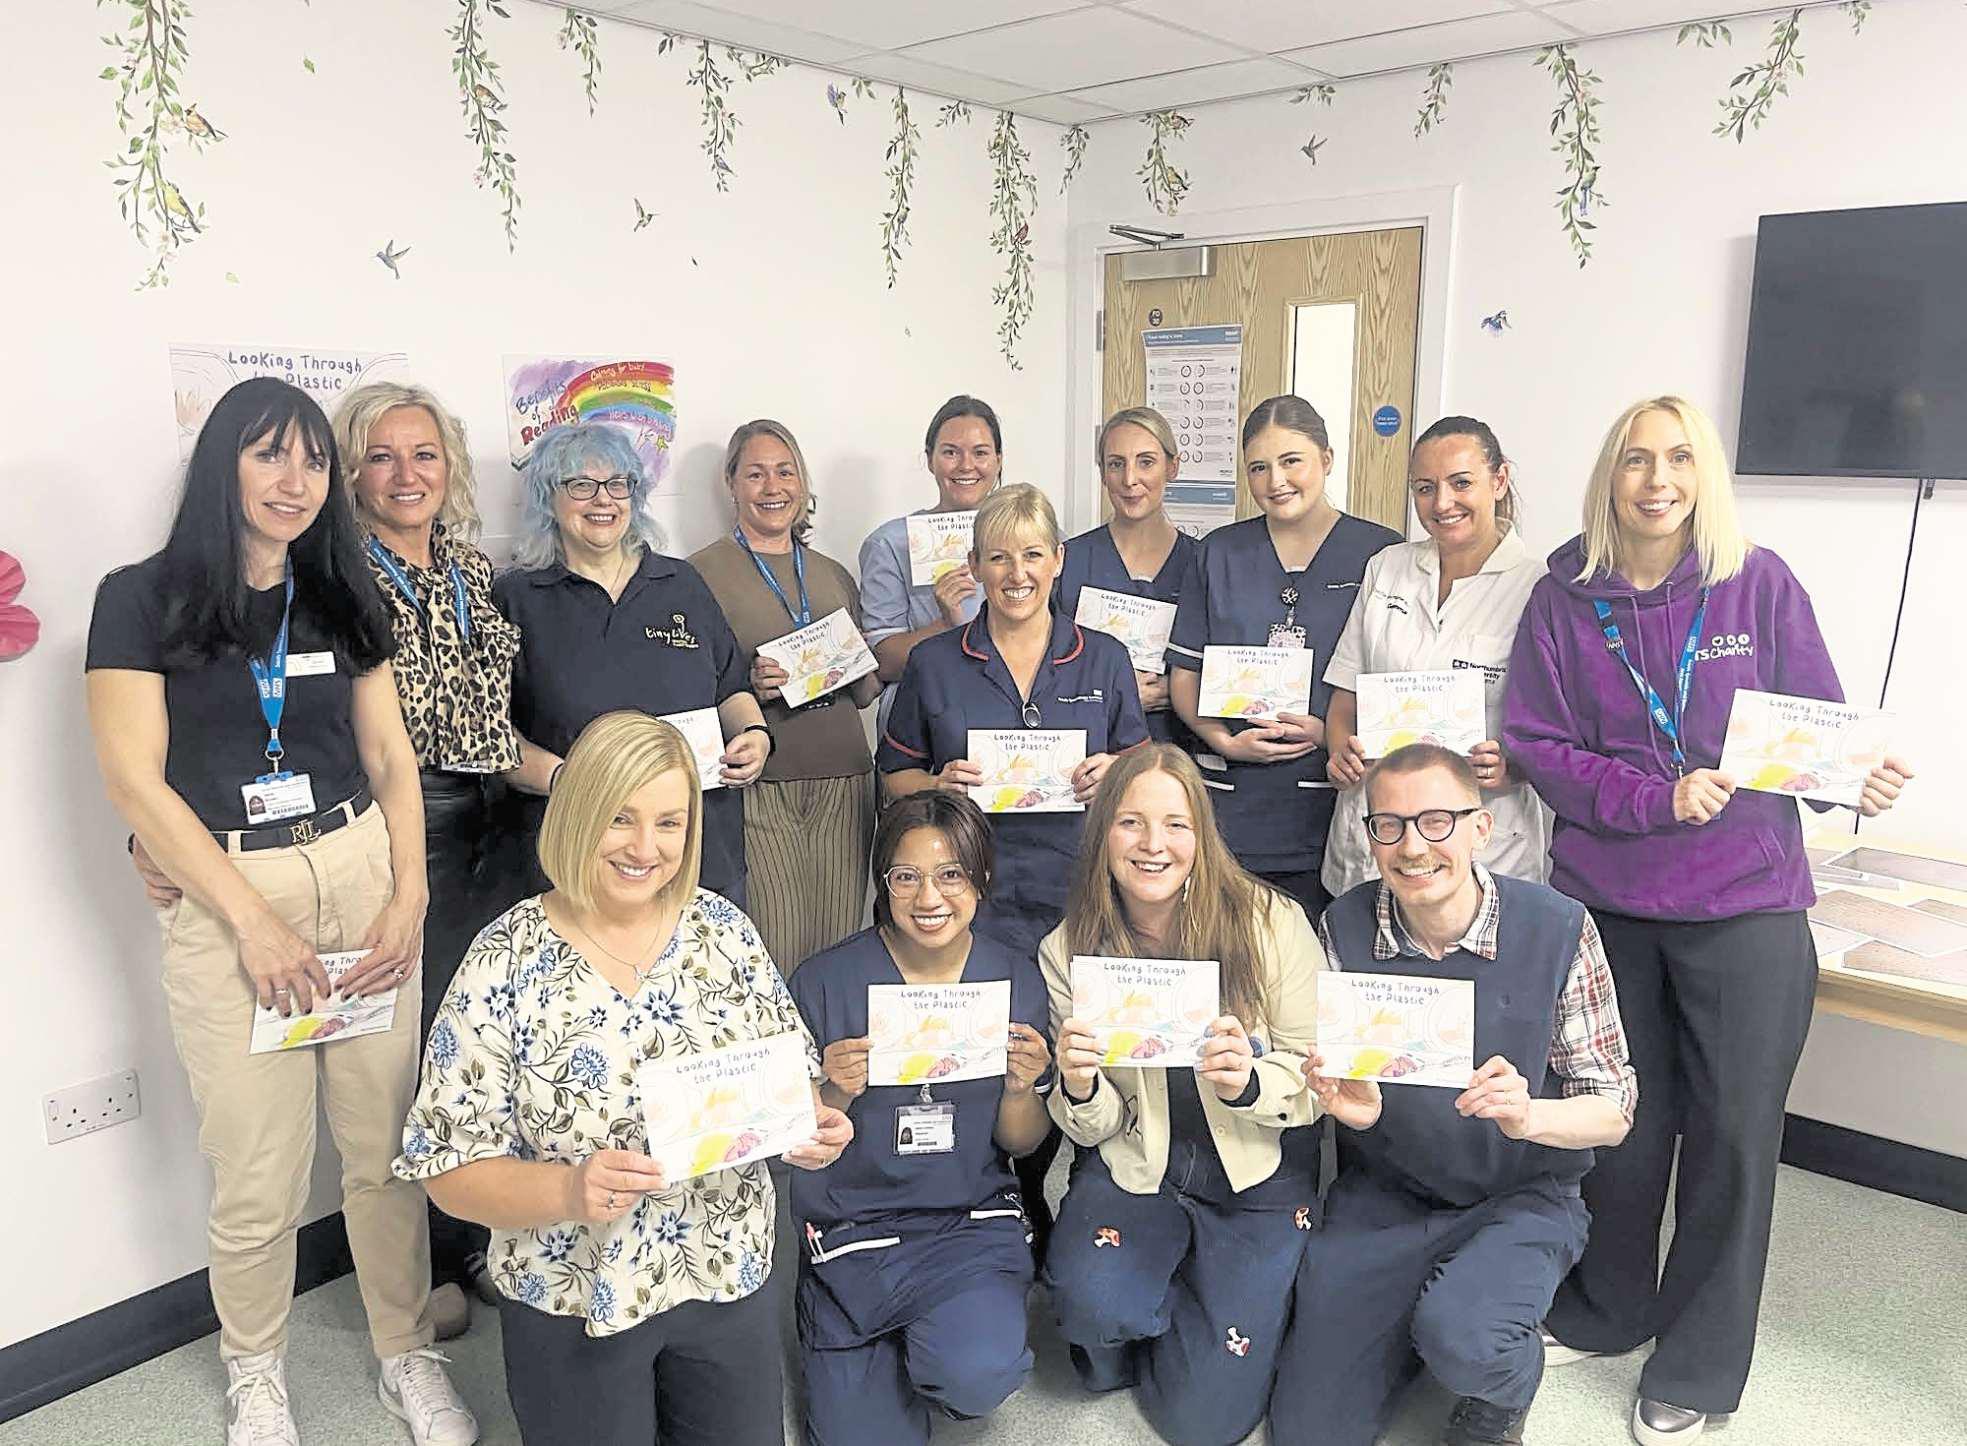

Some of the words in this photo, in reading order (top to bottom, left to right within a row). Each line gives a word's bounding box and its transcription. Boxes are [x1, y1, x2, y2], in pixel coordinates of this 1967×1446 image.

[301, 355, 363, 373] Through
[645, 627, 671, 645] tiny
[1816, 705, 1860, 721] Through
[1147, 965, 1186, 977] Through
[1397, 982, 1440, 996] Through
[727, 1048, 770, 1063] Through
